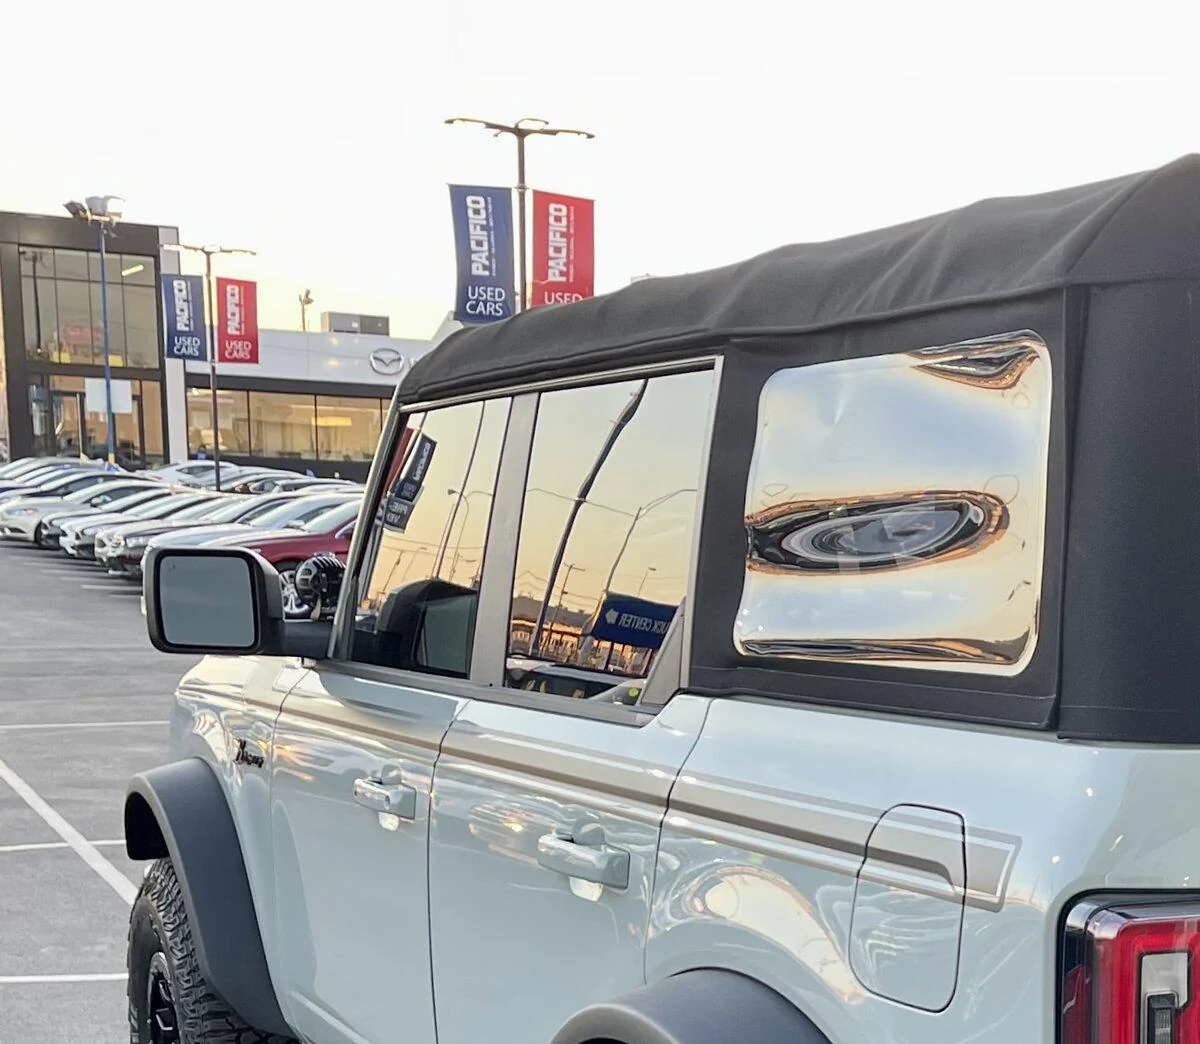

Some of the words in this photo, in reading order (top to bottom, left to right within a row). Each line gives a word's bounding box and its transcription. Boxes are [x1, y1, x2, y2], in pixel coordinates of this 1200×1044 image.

[466, 195, 490, 277] PACIFICO
[548, 202, 568, 283] PACIFICO
[468, 286, 506, 301] USED
[173, 279, 190, 332] PACIFICO
[466, 300, 504, 316] CARS
[174, 336, 201, 347] USED
[225, 340, 252, 350] USED
[173, 345, 200, 356] CARS
[225, 349, 251, 359] CARS
